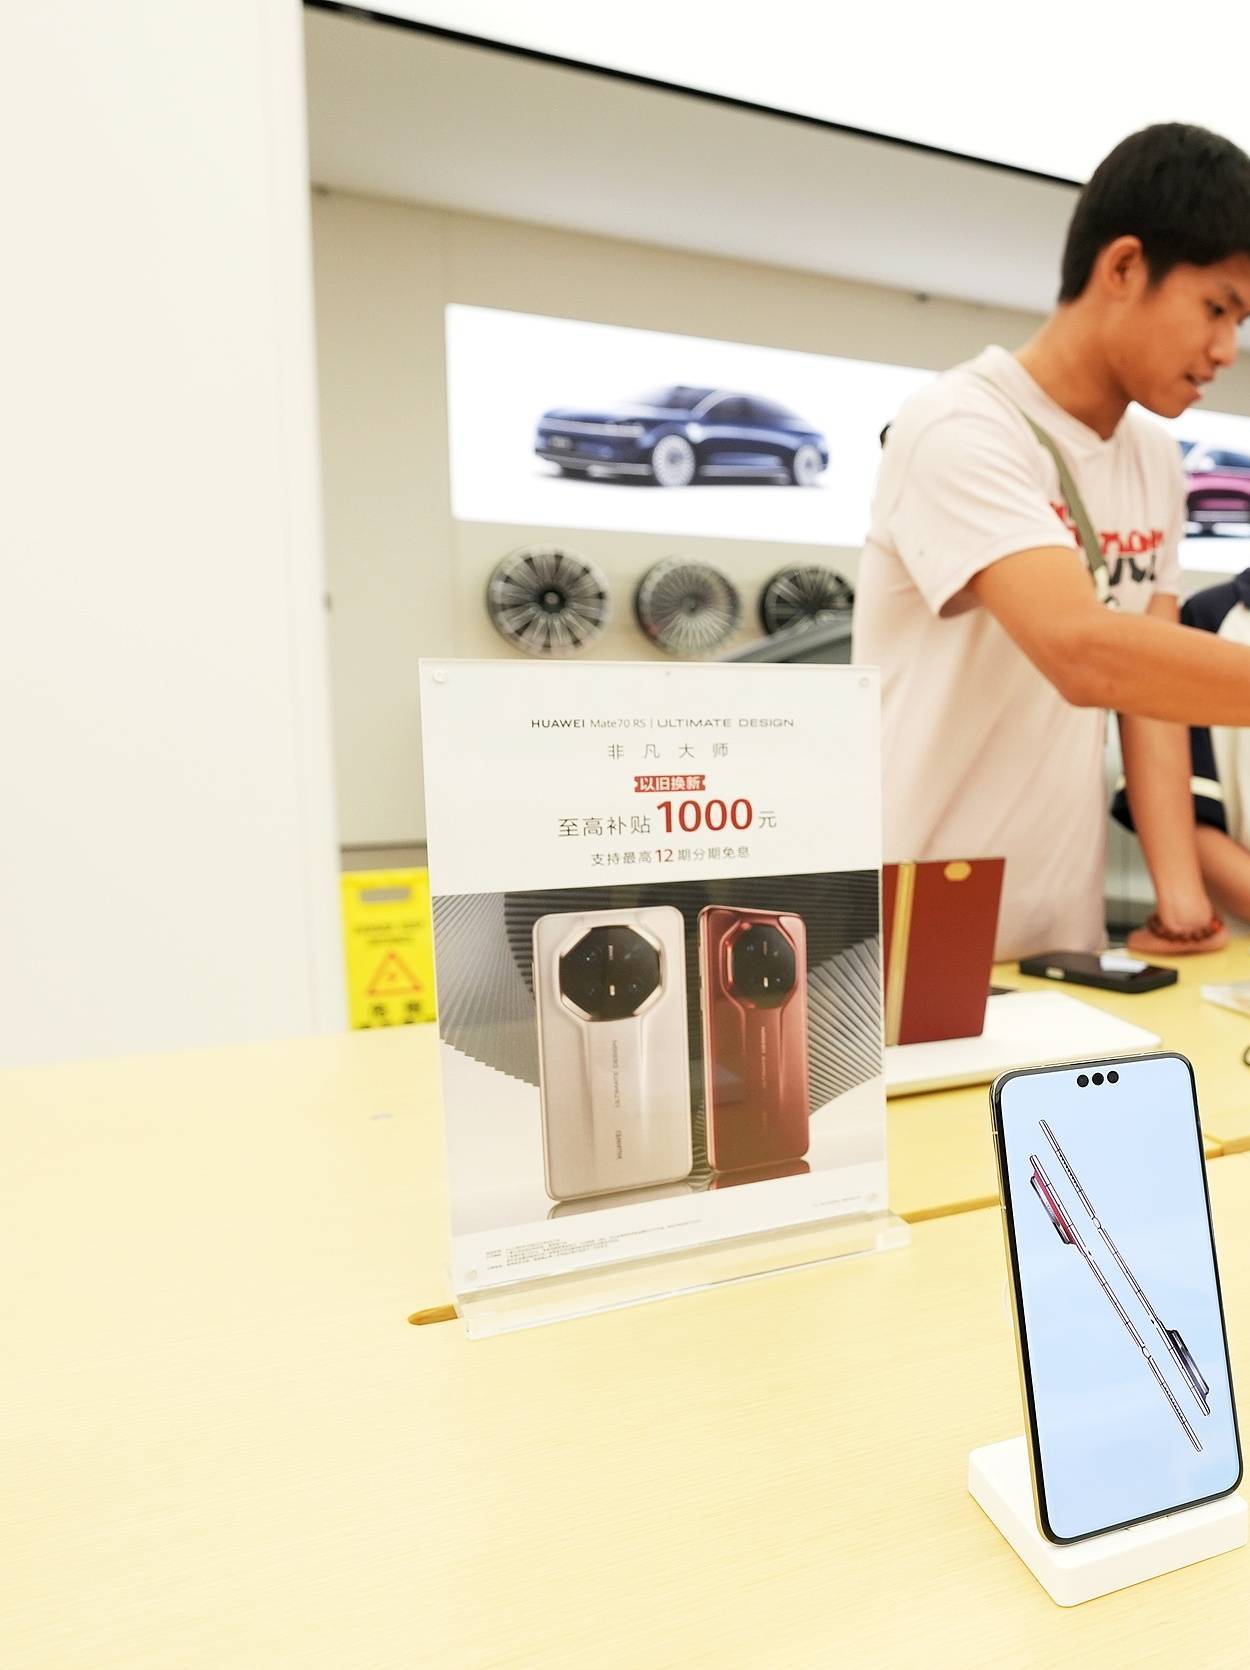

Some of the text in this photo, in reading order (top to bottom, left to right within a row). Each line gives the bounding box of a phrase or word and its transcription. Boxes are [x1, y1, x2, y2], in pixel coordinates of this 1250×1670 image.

[531, 717, 795, 729] HUAWEI Mate70 RS ULTIMATE DESIGN
[607, 742, 729, 760] 非凡大师
[639, 775, 702, 792] 以旧换新
